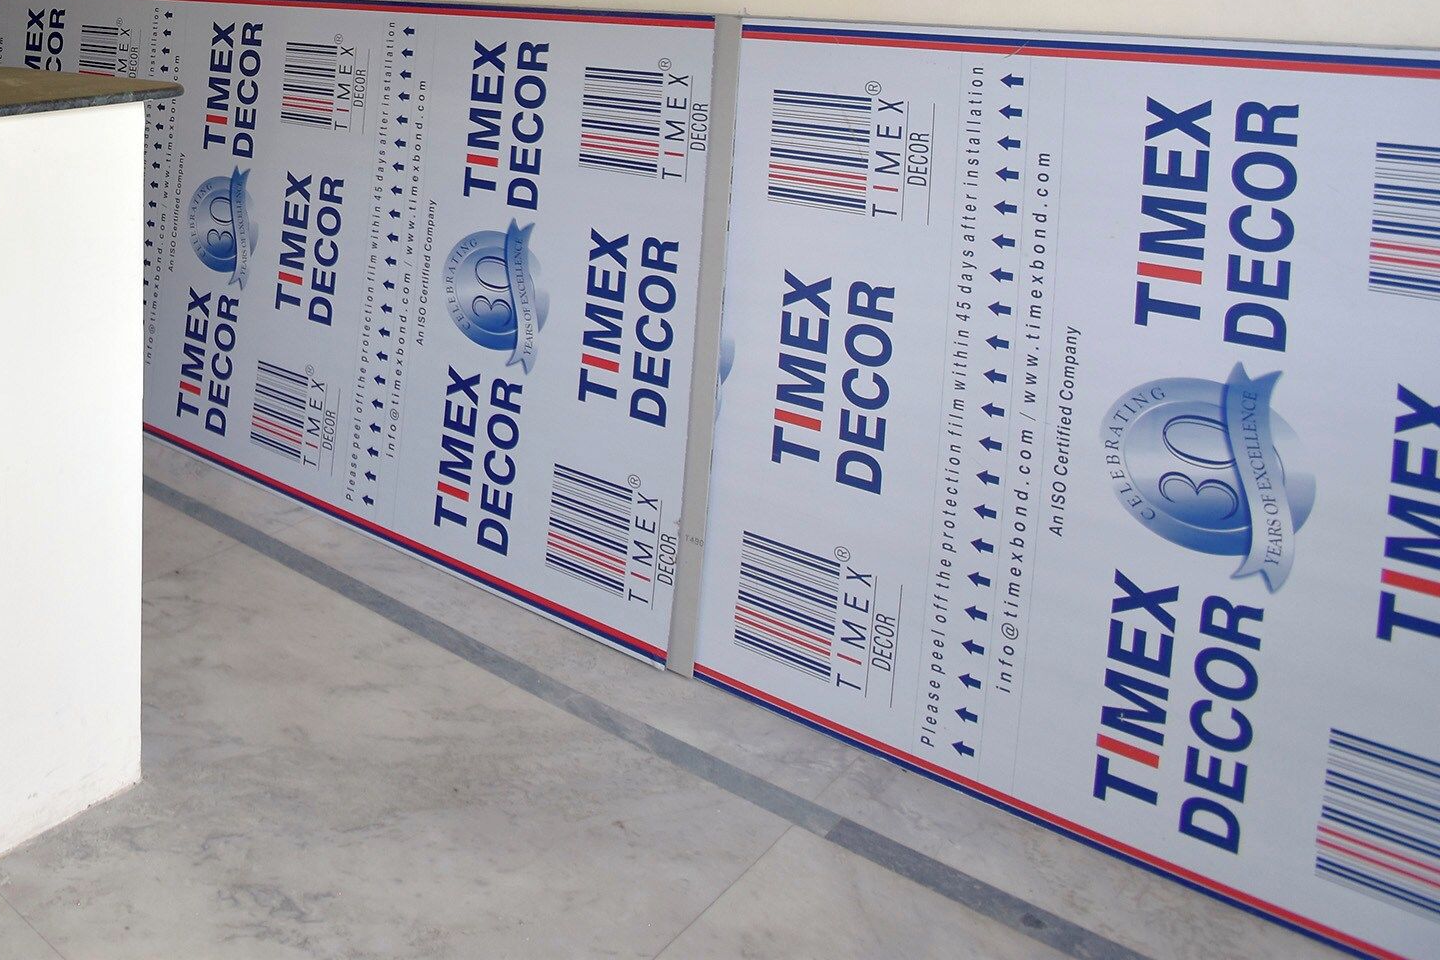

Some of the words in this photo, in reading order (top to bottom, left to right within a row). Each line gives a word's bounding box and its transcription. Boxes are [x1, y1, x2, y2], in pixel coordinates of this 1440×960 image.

[46, 8, 66, 72] COR
[148, 7, 158, 76] installation
[381, 22, 395, 105] installation
[203, 22, 235, 149] TIMEX
[232, 22, 263, 158] DECOR
[353, 70, 366, 107] DECOR
[378, 111, 388, 144] after
[464, 40, 507, 197] TIMEX
[507, 42, 549, 210] DECOR
[690, 104, 708, 151] DECOR
[963, 67, 983, 186] installation
[175, 152, 185, 195] Company
[375, 150, 386, 181] days
[907, 133, 929, 186] DECOR
[171, 197, 180, 237] Certified
[373, 186, 382, 200] 45
[960, 193, 977, 241] after
[1135, 96, 1212, 326] TIMEX
[275, 171, 312, 310] TIMEX
[308, 177, 344, 326] DECOR
[370, 206, 380, 249] within
[423, 199, 437, 251] Company
[1224, 102, 1299, 352] DECOR
[168, 259, 173, 272] An
[366, 254, 376, 281] film
[385, 273, 410, 457] info@timexbond.com
[406, 80, 425, 254] www.timexbond.com
[419, 254, 430, 303] Certified
[446, 238, 478, 331] CELEBRATING
[957, 250, 977, 293] days
[361, 286, 373, 363] protection
[415, 331, 424, 345] An
[417, 307, 426, 327] ISO
[524, 325, 534, 356] YEARS
[578, 228, 629, 402] TIMEX
[630, 237, 679, 427] DECOR
[955, 301, 971, 321] 45
[177, 287, 211, 417] TIMEX
[205, 295, 239, 436] DECOR
[357, 367, 366, 388] the
[772, 269, 832, 463] TIMEX
[951, 329, 969, 389] within
[1059, 325, 1081, 400] Company
[355, 392, 363, 413] off
[836, 282, 895, 495] DECOR
[947, 398, 964, 436] film
[322, 410, 335, 450] DECOR
[352, 417, 361, 449] peel
[434, 365, 480, 527] TIMEX
[995, 429, 1033, 693] info@timexbond.com
[1024, 153, 1050, 402] www.timexbond.com
[1053, 405, 1072, 475] Certified
[1241, 390, 1272, 491] EXCELLENCE
[345, 453, 357, 501] Please
[477, 379, 522, 556] DECOR
[1105, 387, 1166, 521] CELEBRATING
[941, 444, 961, 553] protection
[1050, 481, 1066, 510] ISO
[1377, 384, 1440, 641] TIMEX
[1048, 515, 1063, 537] An
[1264, 519, 1283, 566] YEARS
[657, 534, 676, 586] DECOR
[935, 558, 951, 588] the
[933, 593, 947, 623] off
[872, 614, 895, 671] DECOR
[930, 629, 945, 674] peel
[920, 680, 940, 747] Please
[1093, 569, 1179, 805] TIMEX
[1179, 596, 1264, 854] DECOR
